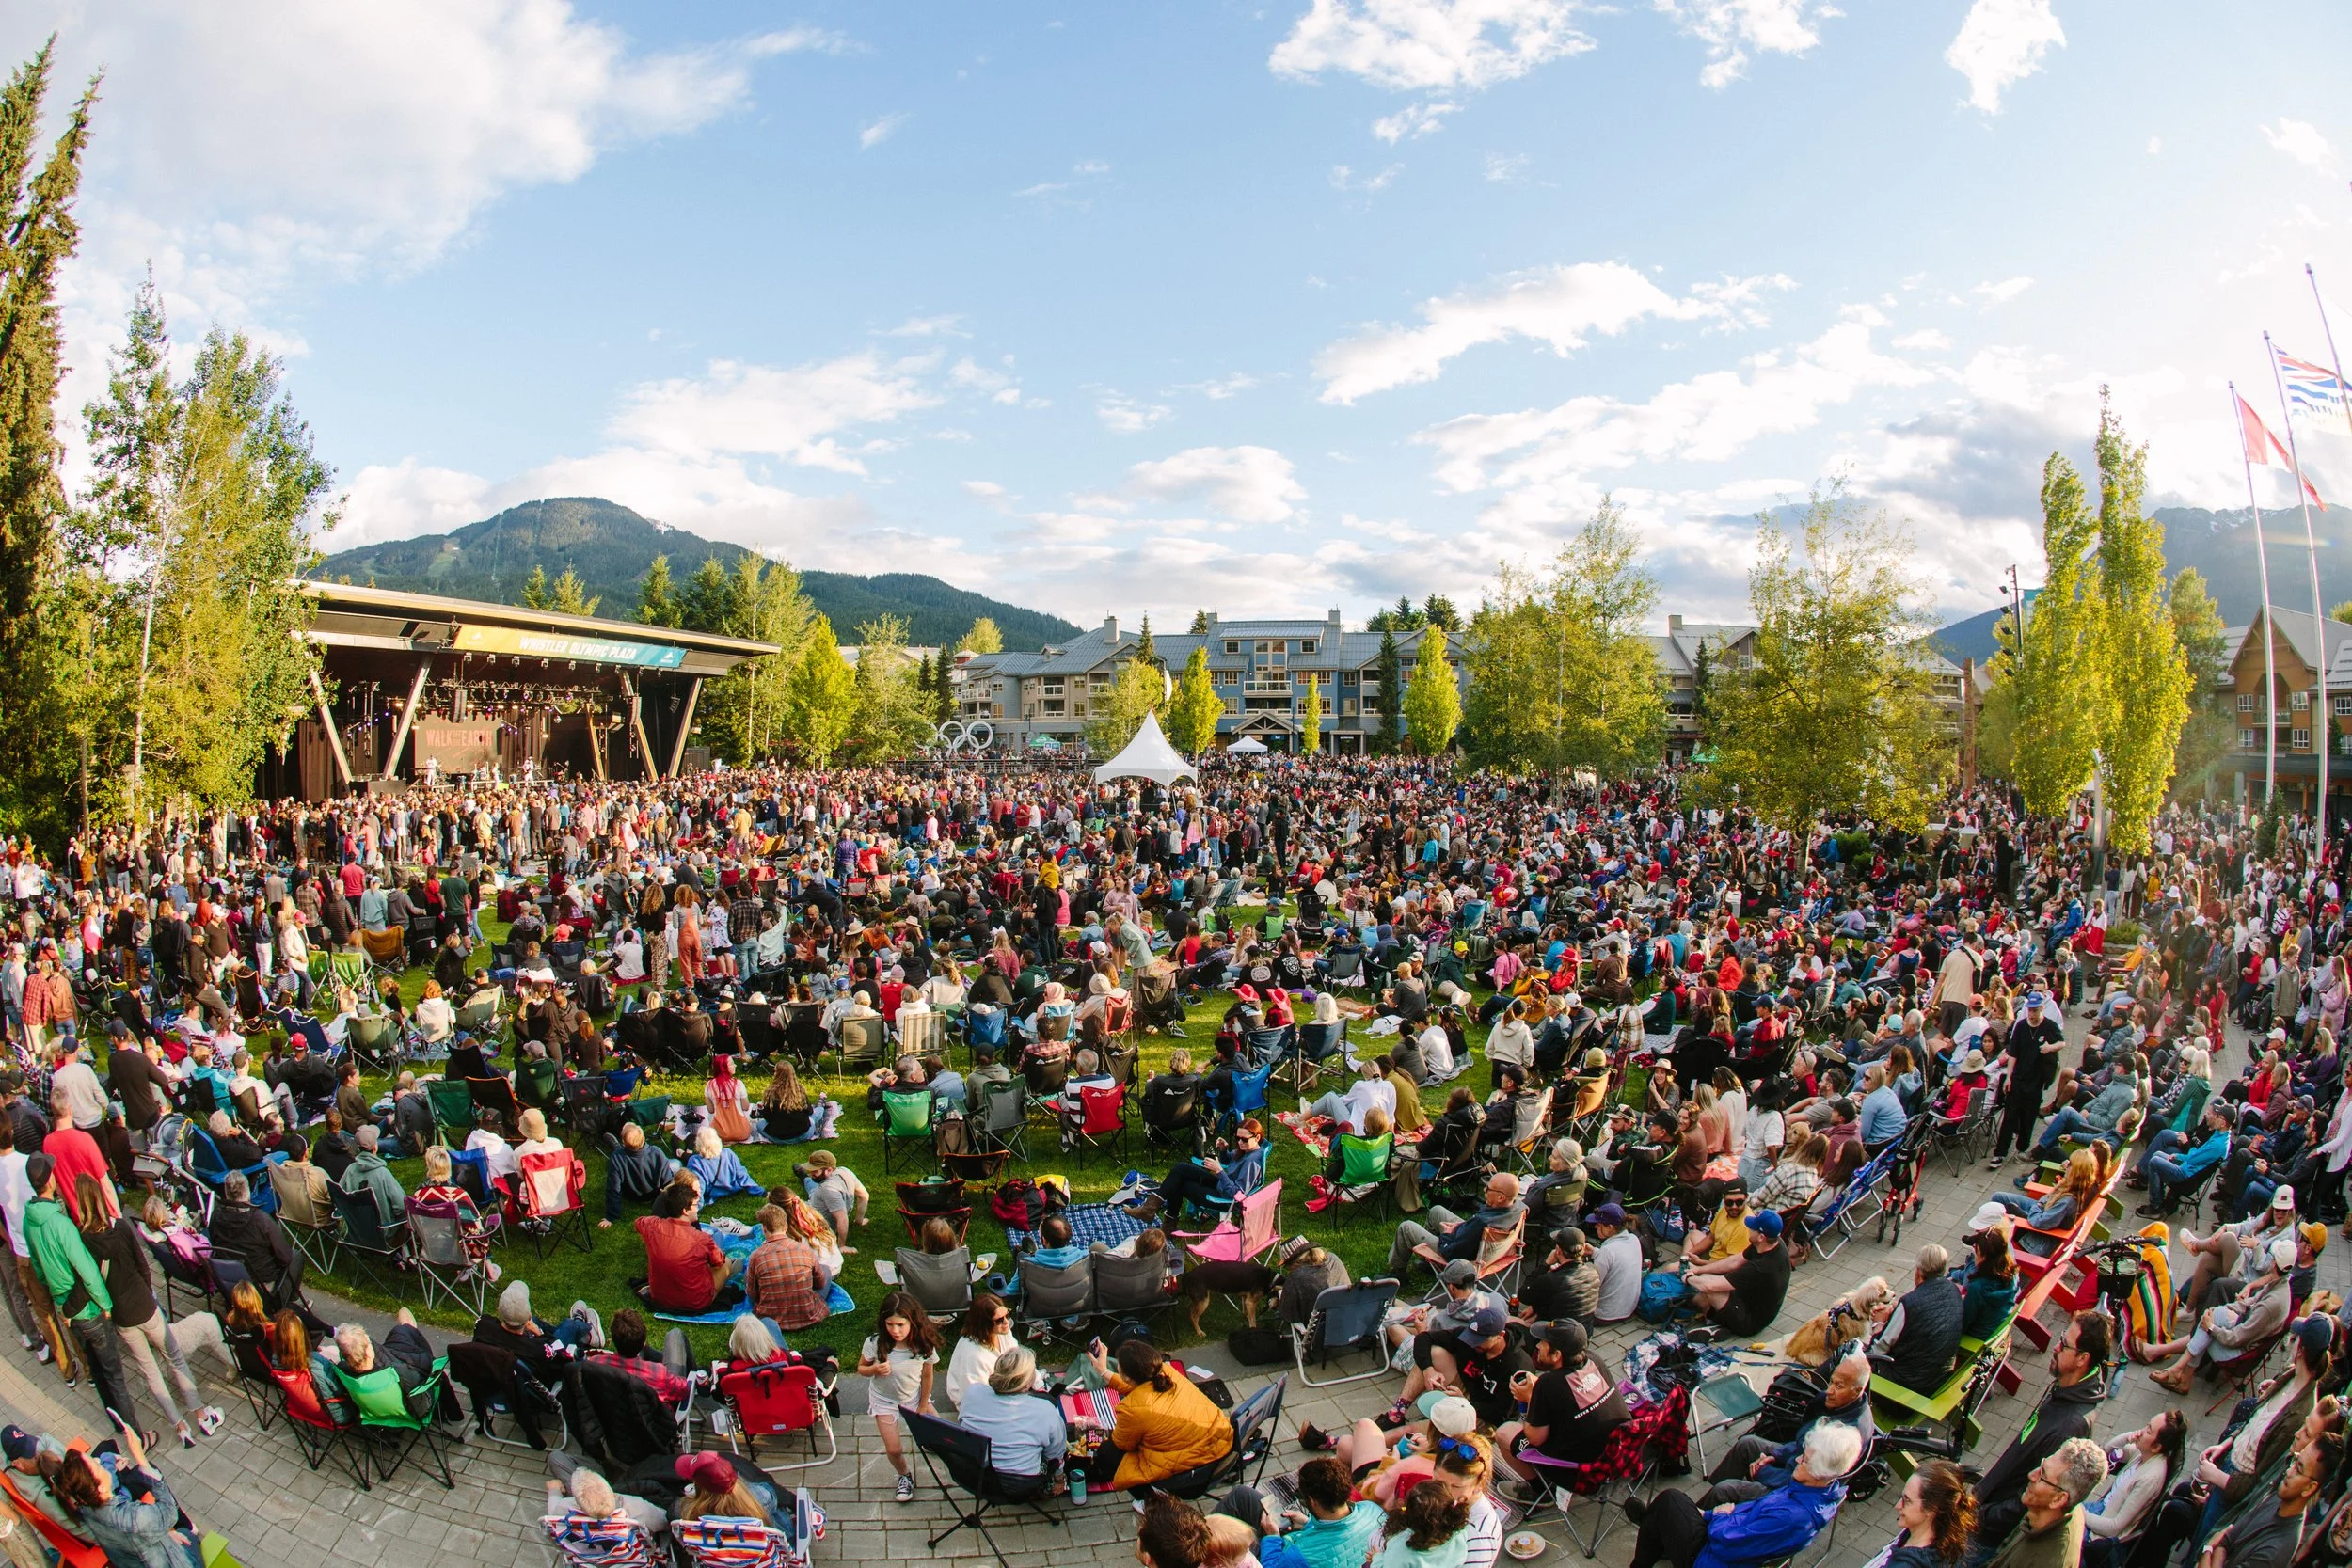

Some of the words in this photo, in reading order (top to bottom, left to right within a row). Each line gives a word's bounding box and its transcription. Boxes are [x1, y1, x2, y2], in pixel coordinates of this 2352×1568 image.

[519, 637, 565, 654] WHISTLER
[569, 642, 607, 657] OLYMPIC
[609, 646, 638, 660] PLAZA
[426, 729, 453, 747] WALK
[461, 729, 492, 747] EARTH
